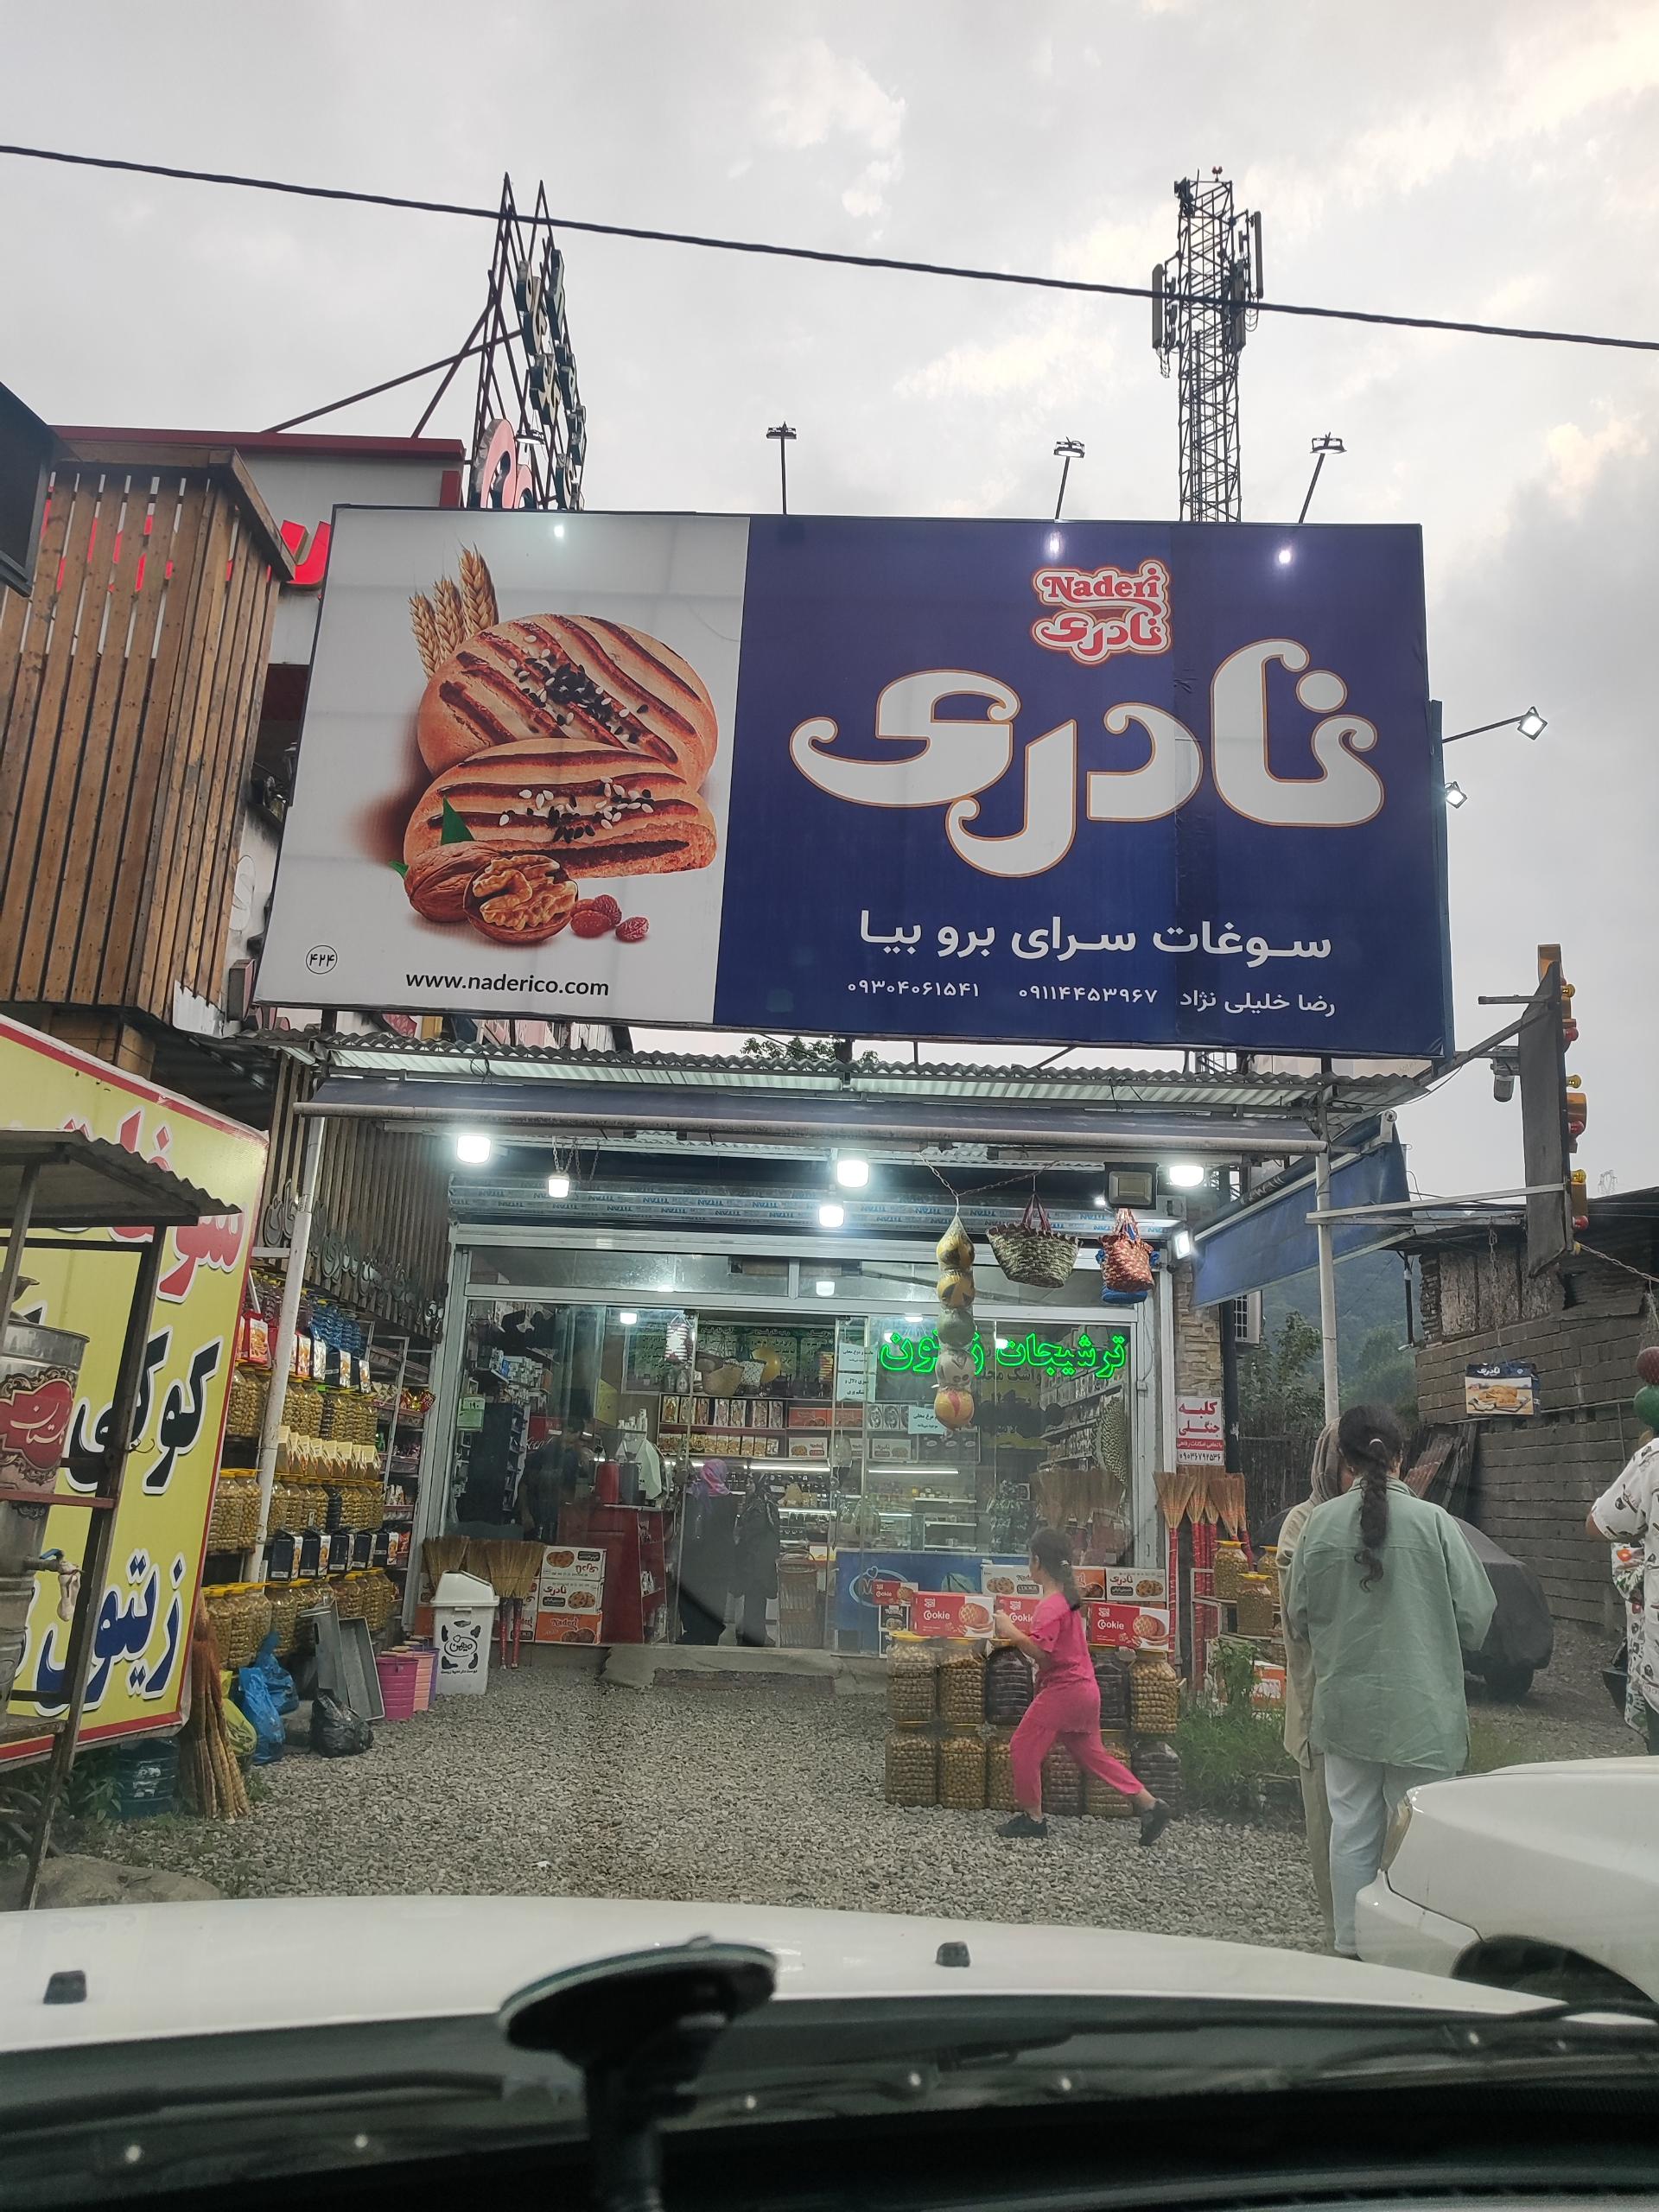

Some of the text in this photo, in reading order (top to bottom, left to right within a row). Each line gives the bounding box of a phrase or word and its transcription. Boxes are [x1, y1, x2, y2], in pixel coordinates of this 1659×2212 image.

[1040, 566, 1162, 610] Naderi
[1039, 610, 1163, 652] نادری
[789, 639, 1384, 878] نادری
[861, 910, 1332, 967] سوغات سرای برو بیا
[406, 973, 609, 996] www.naderico.com
[848, 980, 1335, 1017] رضا خلیلی نژاد ۰۹۱۱۴۴۵۳۹۶۷ ۰۹۳۰۴۰۶۱۵۴۱
[1179, 1401, 1217, 1419] کلبه
[1179, 1420, 1220, 1438] جنگلی
[923, 1610, 950, 1621] Cookie
[1097, 1618, 1125, 1630] Cookie
